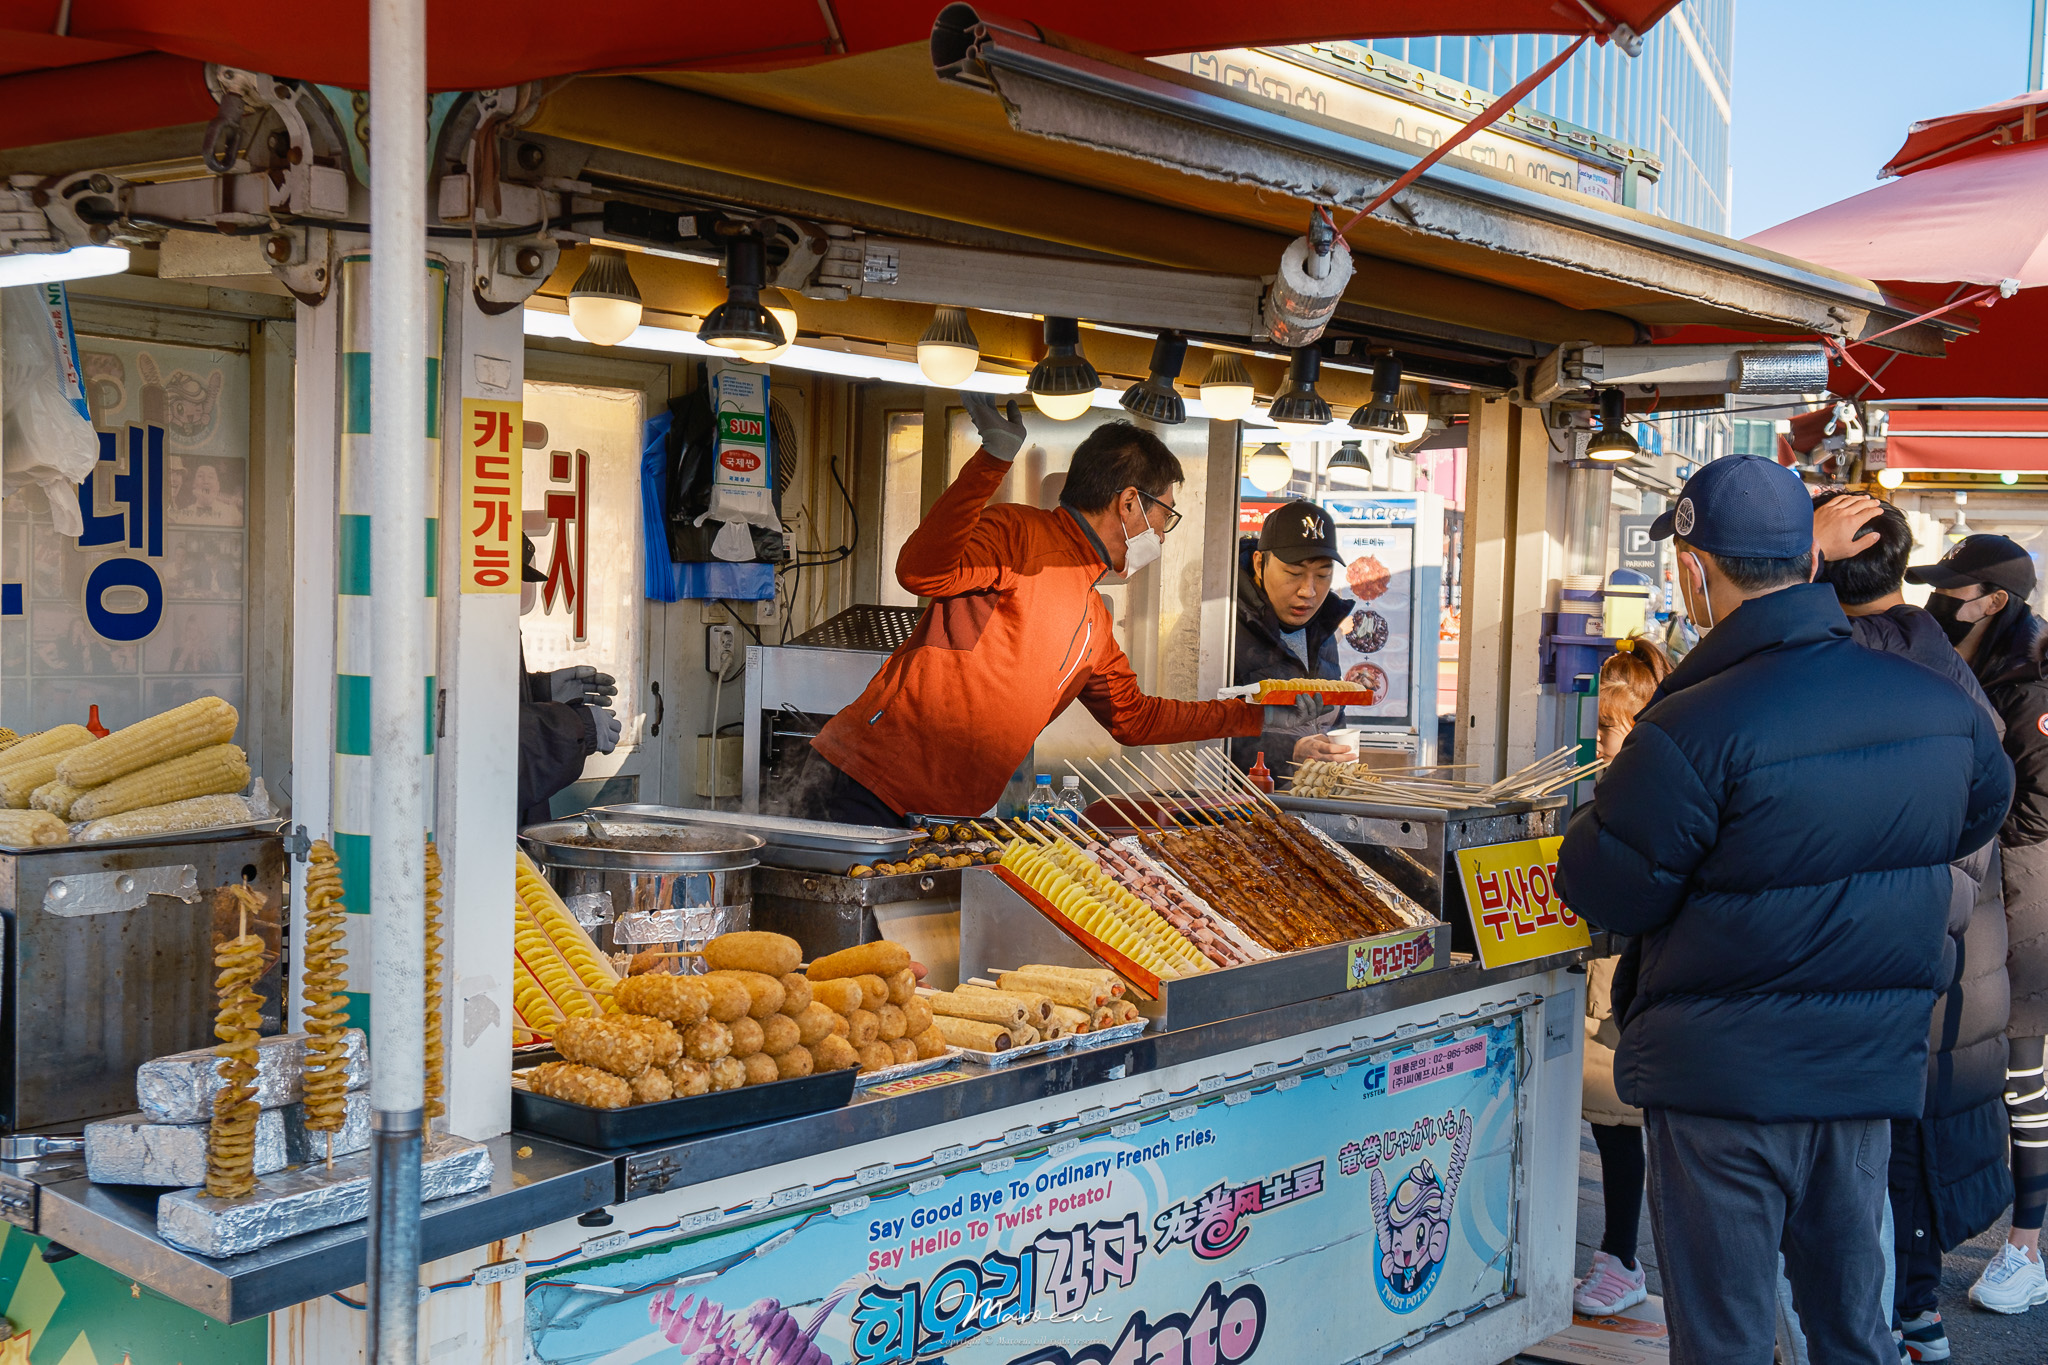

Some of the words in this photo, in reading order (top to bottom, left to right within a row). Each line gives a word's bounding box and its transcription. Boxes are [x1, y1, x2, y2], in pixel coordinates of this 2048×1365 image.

[729, 418, 762, 436] SUN
[725, 456, 755, 470] 국제썬
[472, 409, 513, 587] 카드가능
[1353, 537, 1385, 547] 세트메뉴
[1632, 530, 1650, 551] P
[1624, 559, 1656, 568] PARKING
[1371, 940, 1418, 978] 닭꼬치
[1393, 1056, 1426, 1076] 제품문의
[1433, 1041, 1483, 1064] 02-965-5888
[1363, 1065, 1386, 1091] CF
[1362, 1087, 1386, 1100] SYSTEM
[869, 1217, 905, 1241] Say
[911, 1196, 963, 1228] Good
[970, 1189, 1003, 1213] Bye
[1009, 1180, 1030, 1200] To
[1116, 1138, 1170, 1169] French
[868, 1247, 904, 1271] Say
[910, 1229, 962, 1259] Hello
[967, 1220, 989, 1241] To
[1381, 1283, 1405, 1309] TWIST
[1405, 1271, 1437, 1309] POTATO
